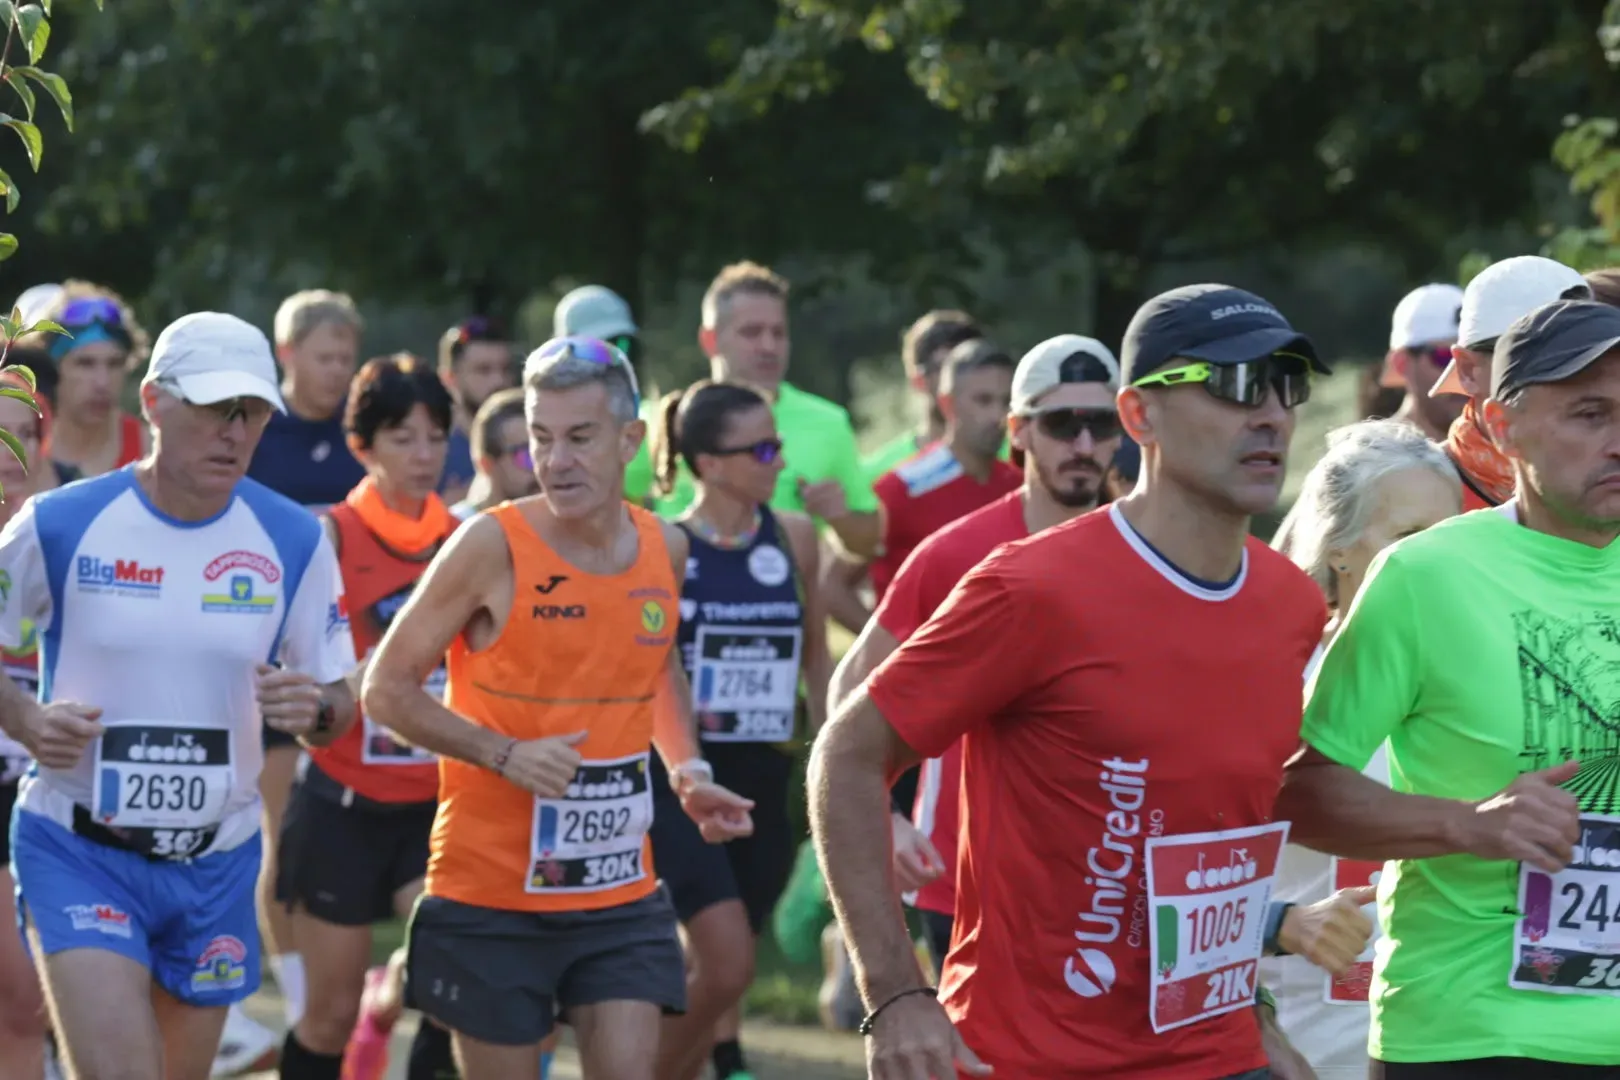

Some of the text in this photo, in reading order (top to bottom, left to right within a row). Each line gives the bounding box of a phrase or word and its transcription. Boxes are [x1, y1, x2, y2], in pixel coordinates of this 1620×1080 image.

[77, 556, 165, 583] BigMat
[532, 604, 586, 618] KING
[126, 774, 206, 811] 2630
[563, 806, 631, 843] 2692
[582, 852, 638, 885] 30K
[1074, 757, 1149, 943] UniCredit
[1186, 896, 1248, 956] 1005
[1203, 961, 1253, 1010] 21K
